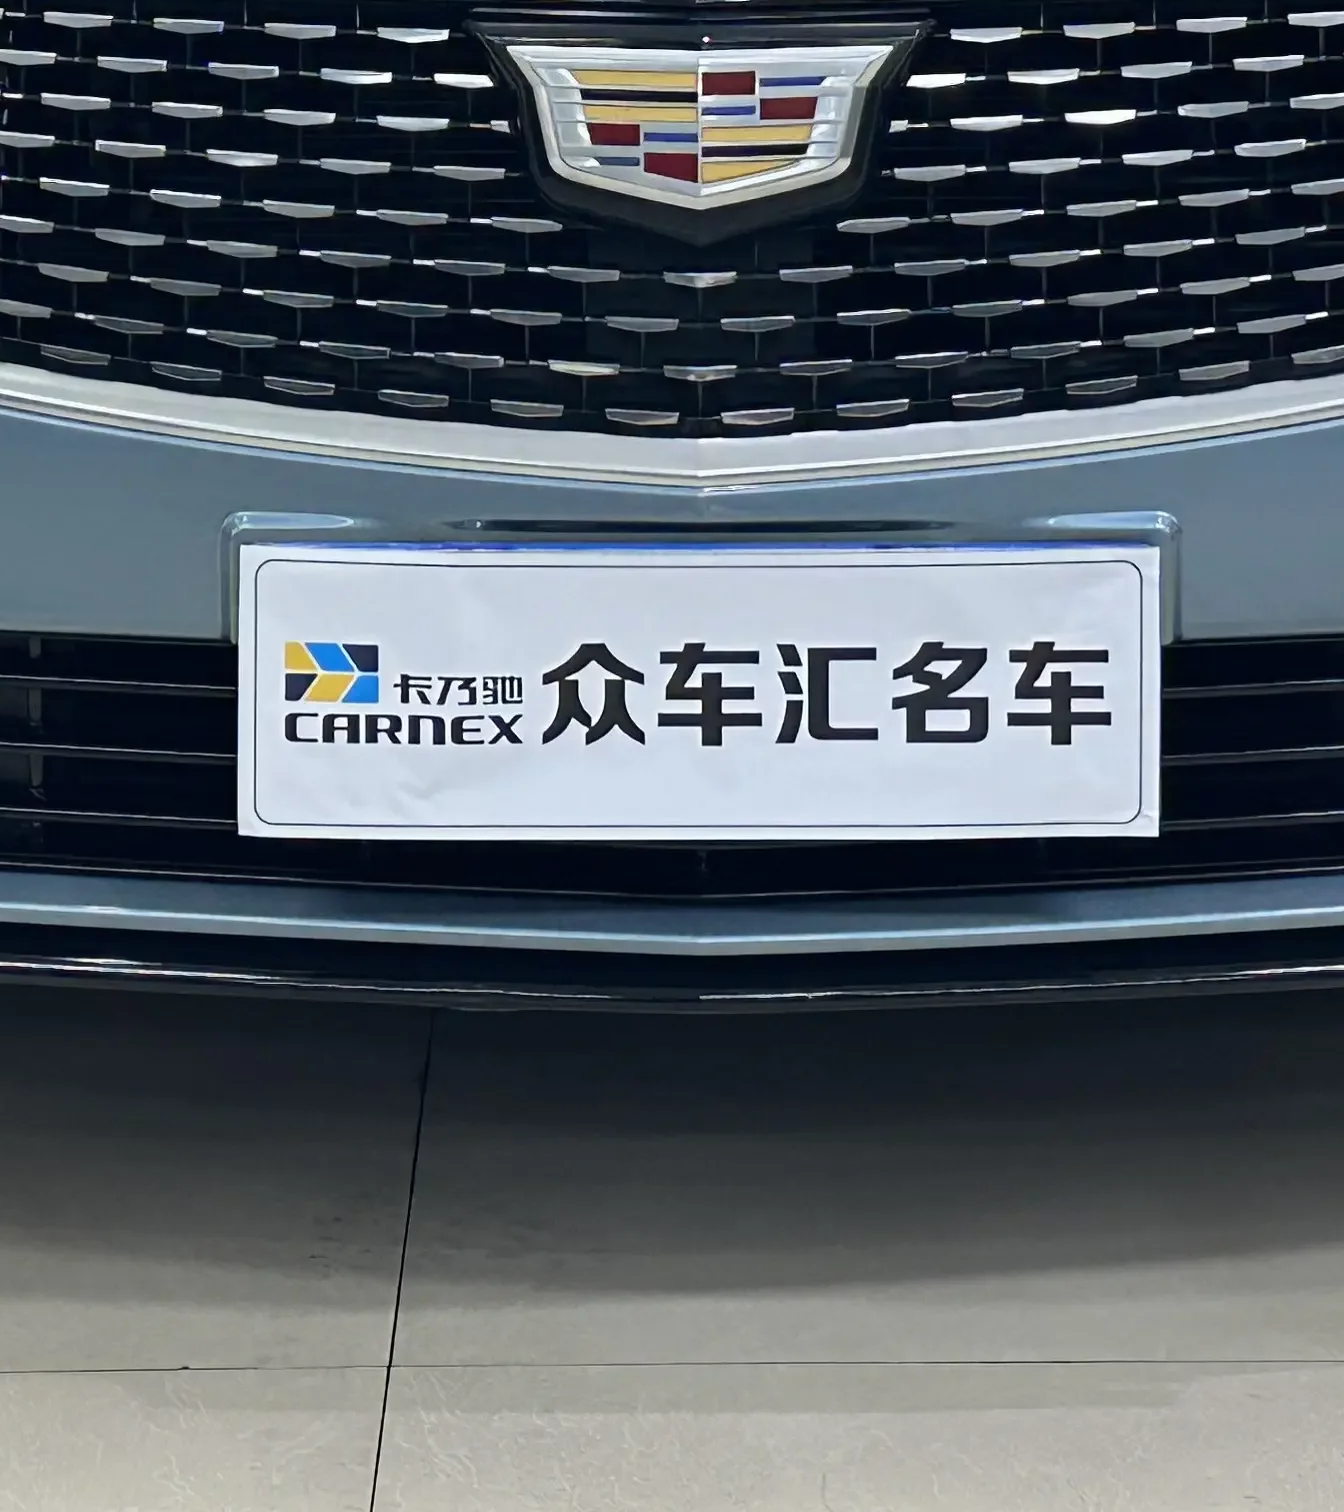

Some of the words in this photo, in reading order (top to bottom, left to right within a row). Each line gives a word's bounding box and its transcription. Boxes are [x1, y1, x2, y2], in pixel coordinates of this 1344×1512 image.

[284, 712, 524, 746] CARNEX
[542, 641, 1112, 747] 众车汇名车
